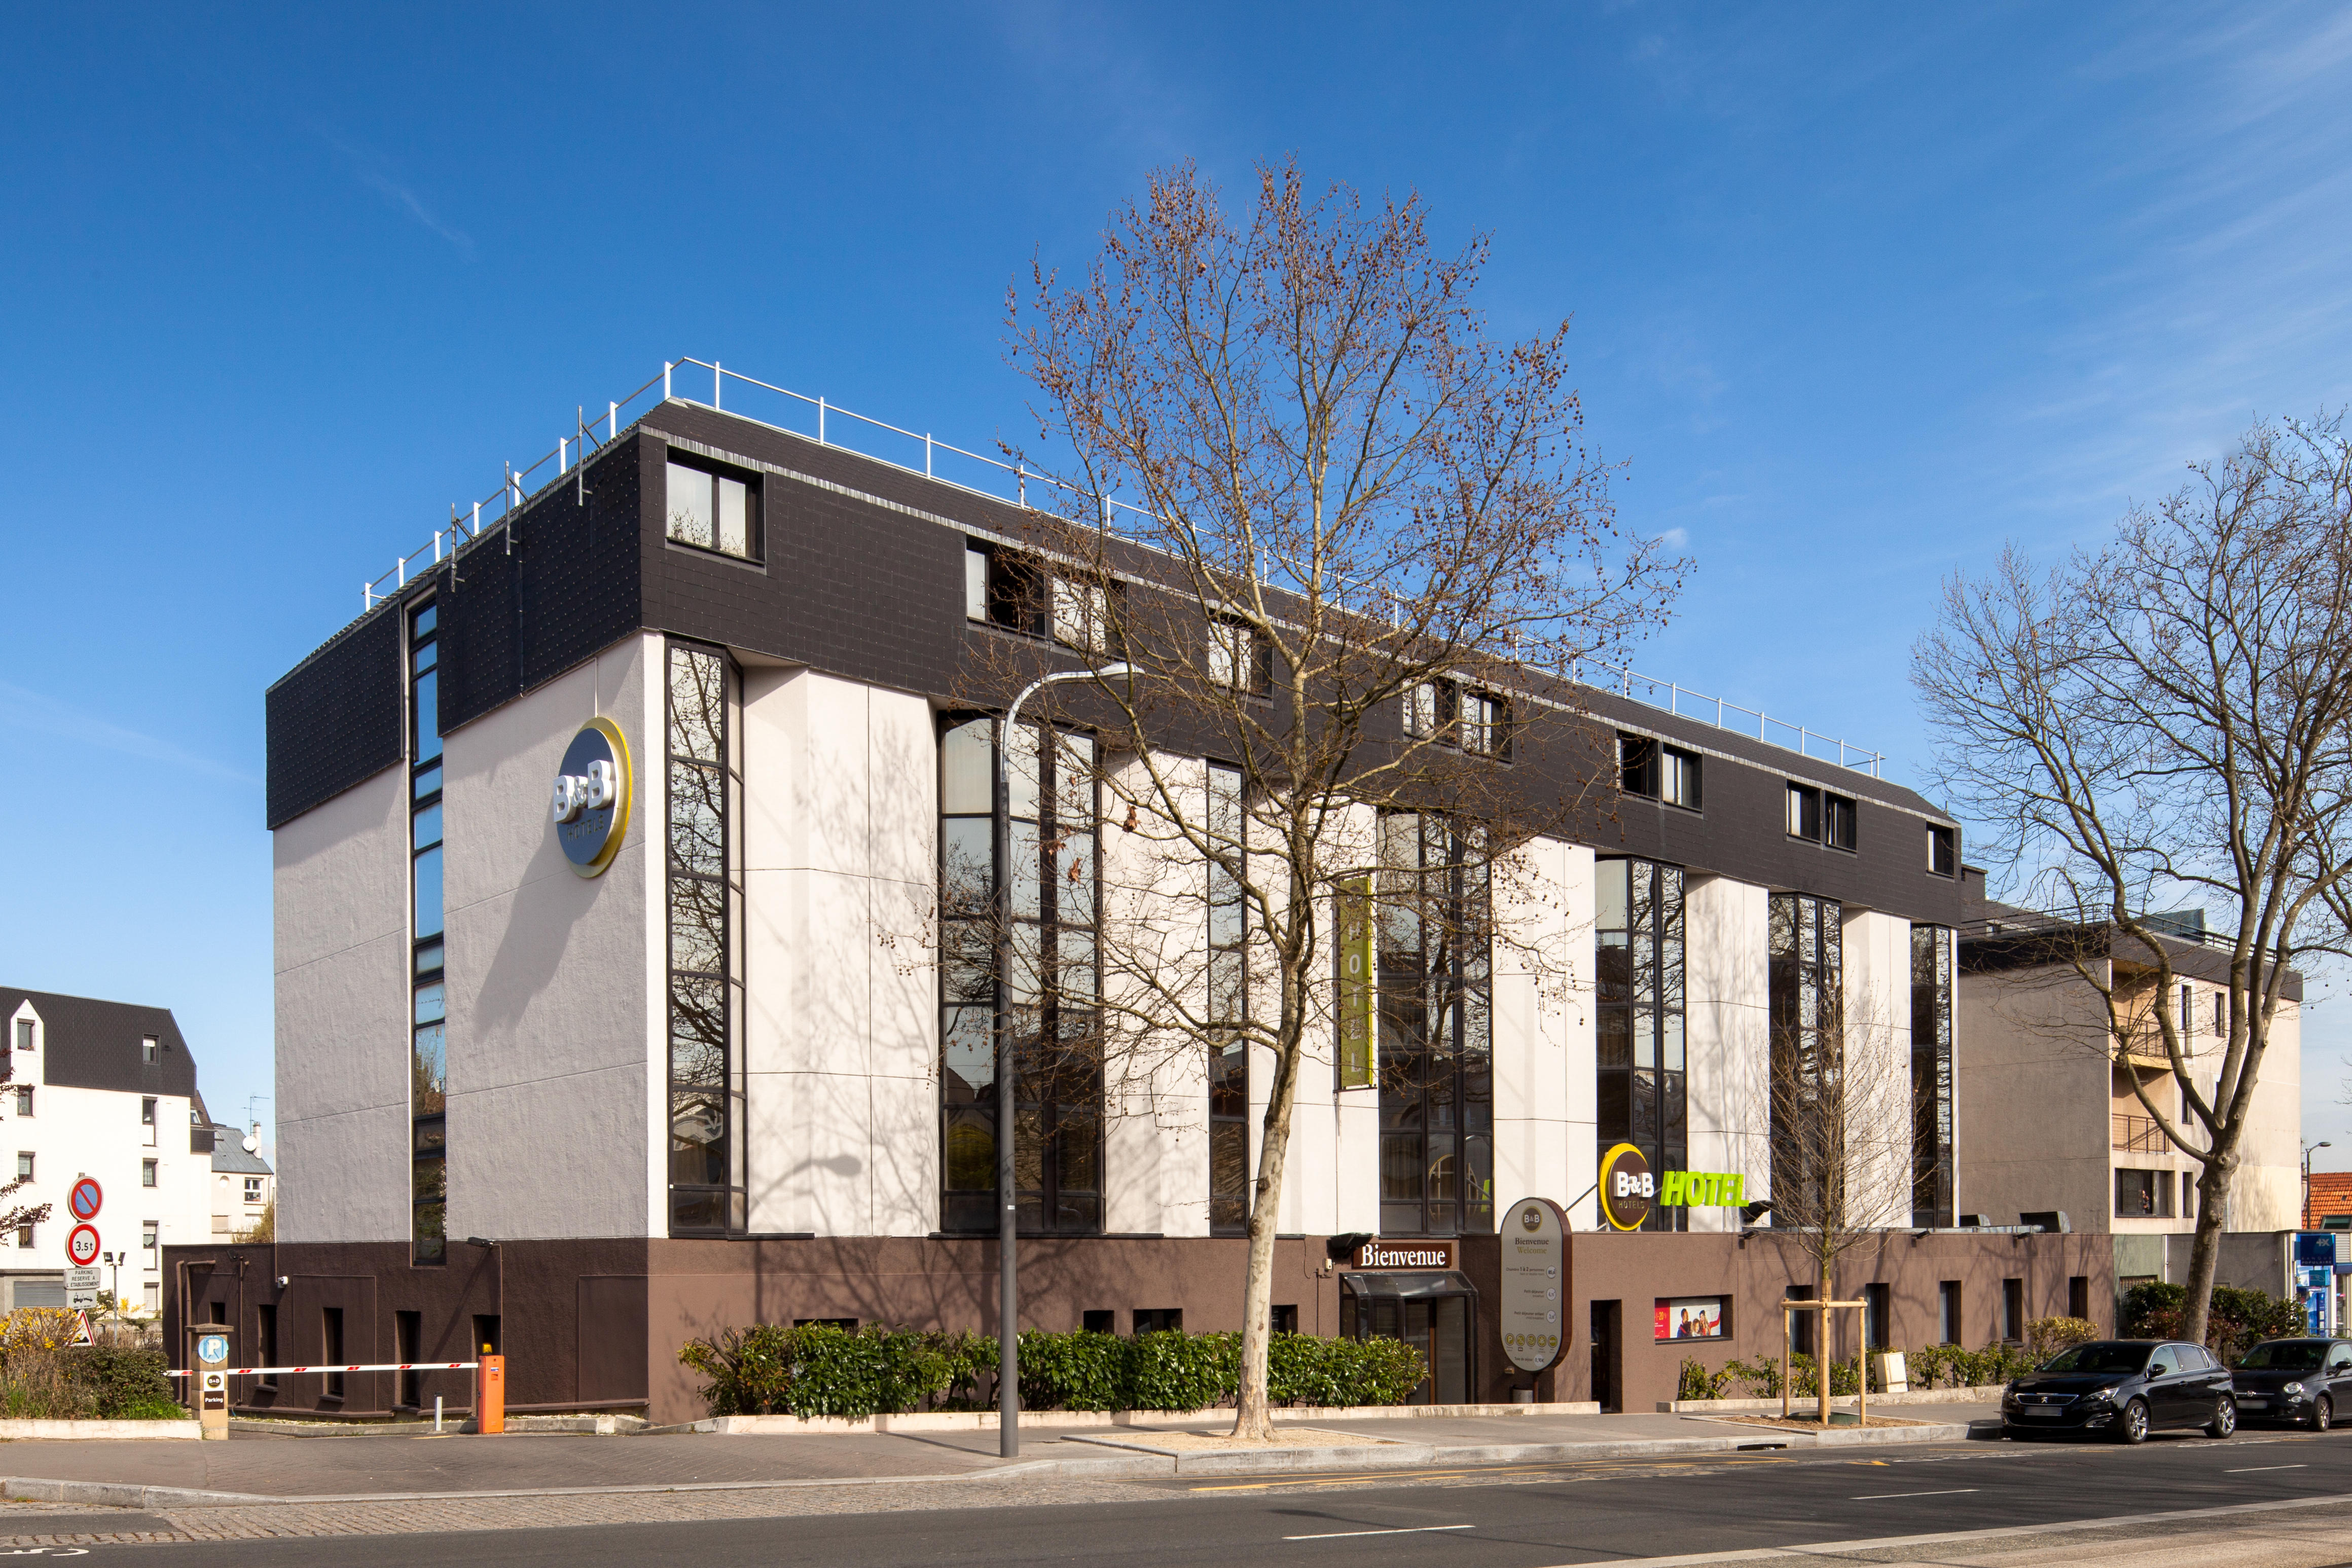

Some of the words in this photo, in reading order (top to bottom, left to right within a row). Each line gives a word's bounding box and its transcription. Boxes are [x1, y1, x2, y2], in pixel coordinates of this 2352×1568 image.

[553, 760, 612, 823] B&B
[567, 814, 604, 843] HOTELS
[1349, 920, 1361, 1073] HOTEL
[1614, 1171, 1654, 1198] B&B
[1660, 1171, 1750, 1207] HOTEL
[1524, 1214, 1540, 1223] B&B
[1618, 1200, 1645, 1209] HOTELS
[1361, 1244, 1445, 1266] Bienvenue
